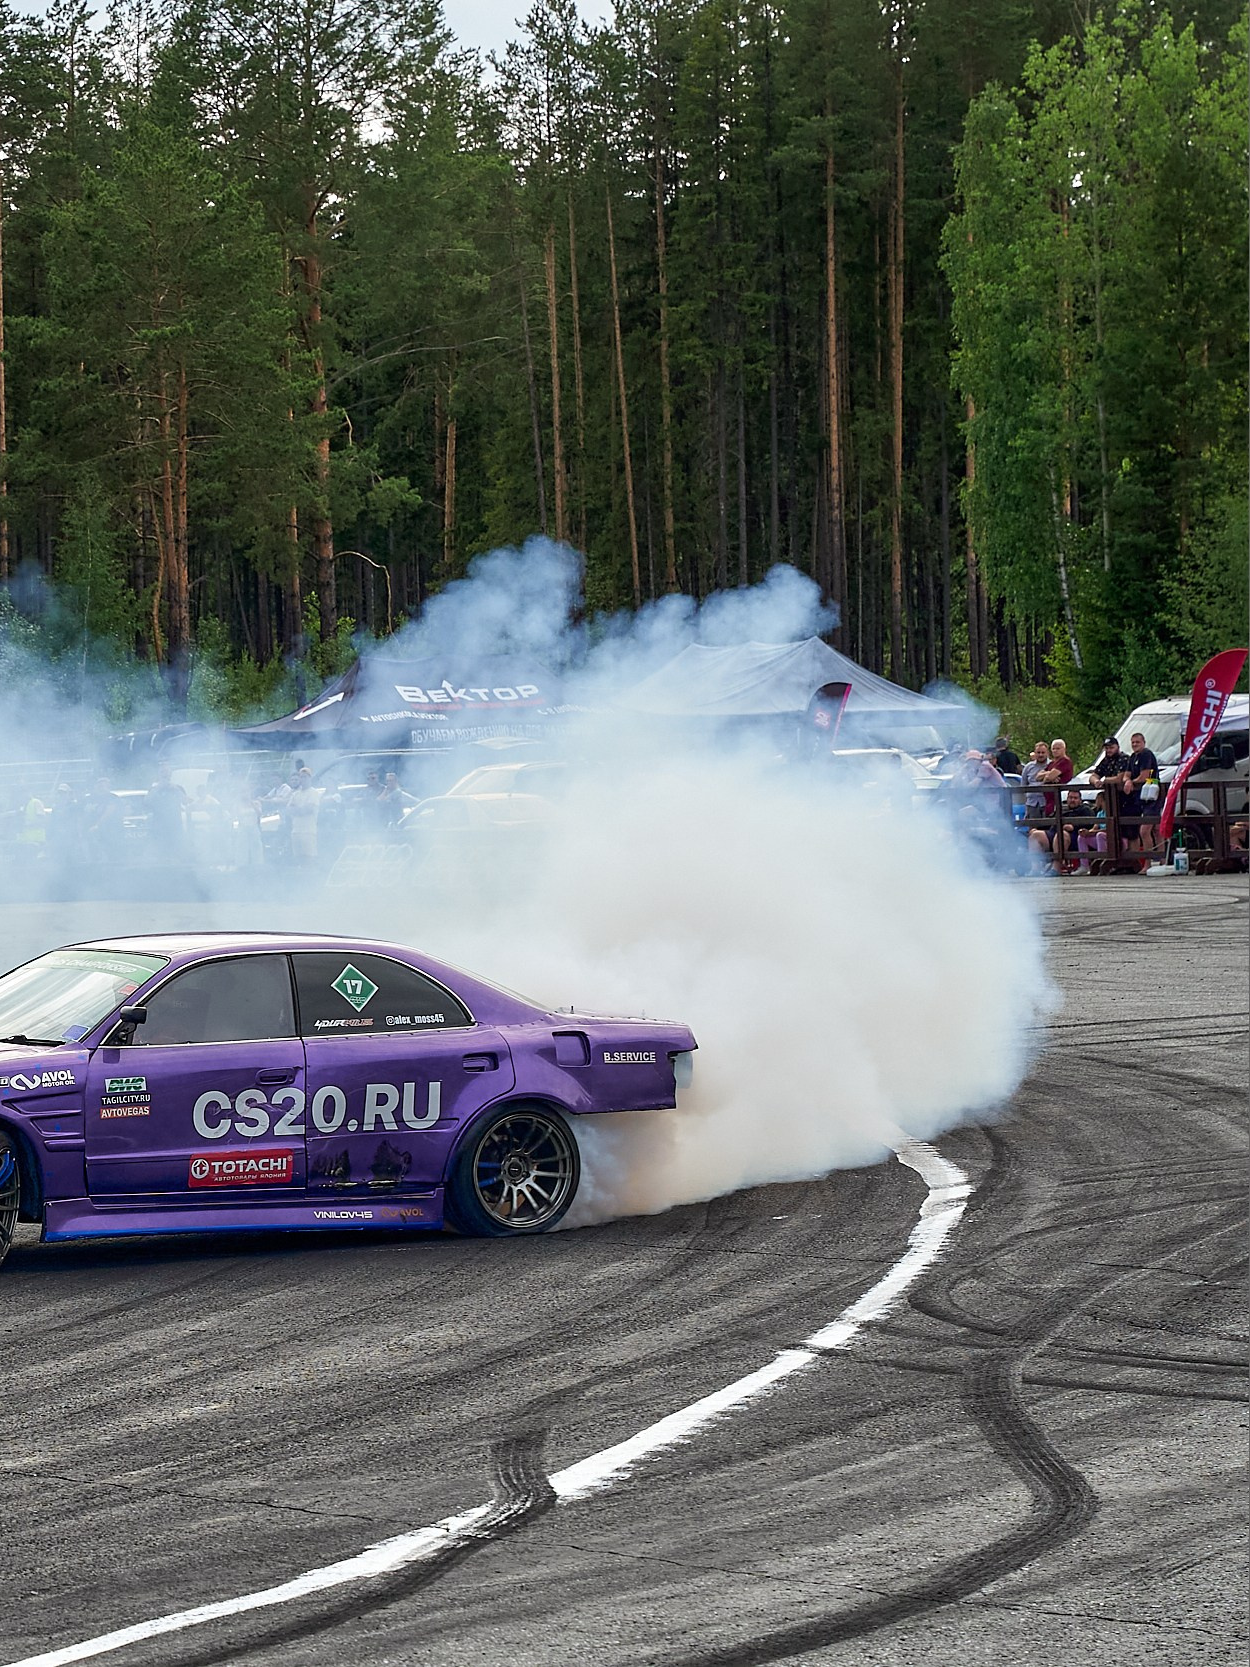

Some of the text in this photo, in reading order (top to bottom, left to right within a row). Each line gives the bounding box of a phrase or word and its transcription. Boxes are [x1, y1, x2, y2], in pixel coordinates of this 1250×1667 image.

[342, 979, 363, 994] 17
[386, 1013, 445, 1026] @alex_moss45
[604, 1052, 656, 1062] B.SERVICE
[41, 1069, 75, 1083] AVOL
[42, 1080, 63, 1088] MOTOR
[101, 1094, 151, 1104] TAGILCITY.RU
[101, 1106, 150, 1118] AVTOVEGAS
[193, 1081, 442, 1139] CS20.RU
[211, 1158, 287, 1174] TOTACHI
